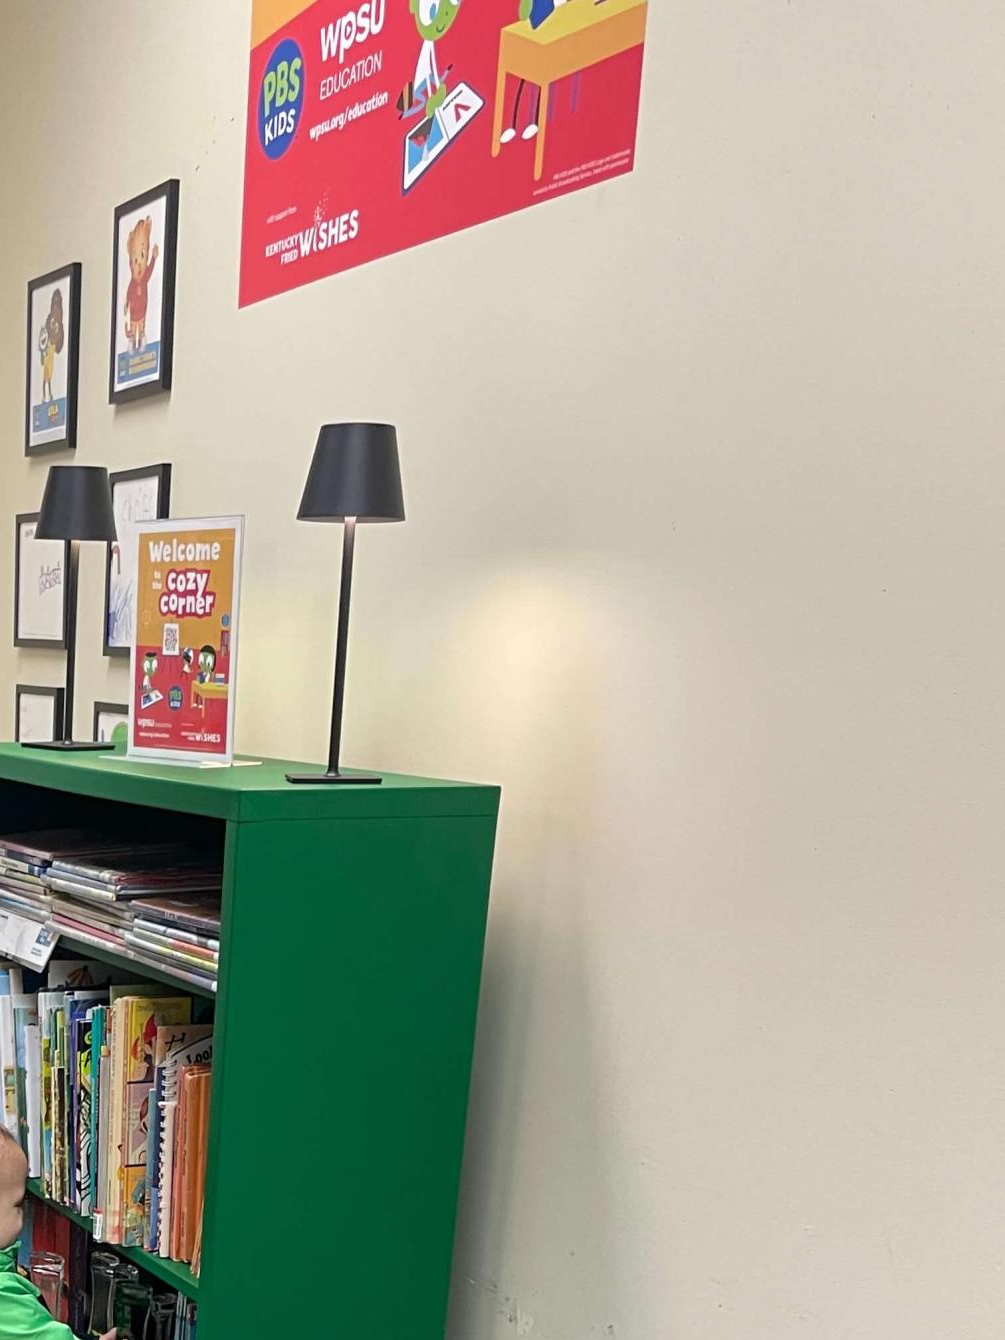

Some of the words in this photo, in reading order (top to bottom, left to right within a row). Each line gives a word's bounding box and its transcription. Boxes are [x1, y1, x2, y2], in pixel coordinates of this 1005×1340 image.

[263, 57, 302, 118] PBS
[319, 50, 383, 101] EDUCATION
[264, 108, 296, 146] KIDS
[309, 91, 389, 142] wpsu.org/education
[265, 232, 300, 258] KENTUCKY
[298, 208, 360, 258] WISHES
[148, 538, 221, 563] Welcome
[160, 593, 214, 615] corner
[167, 571, 208, 600] cozy
